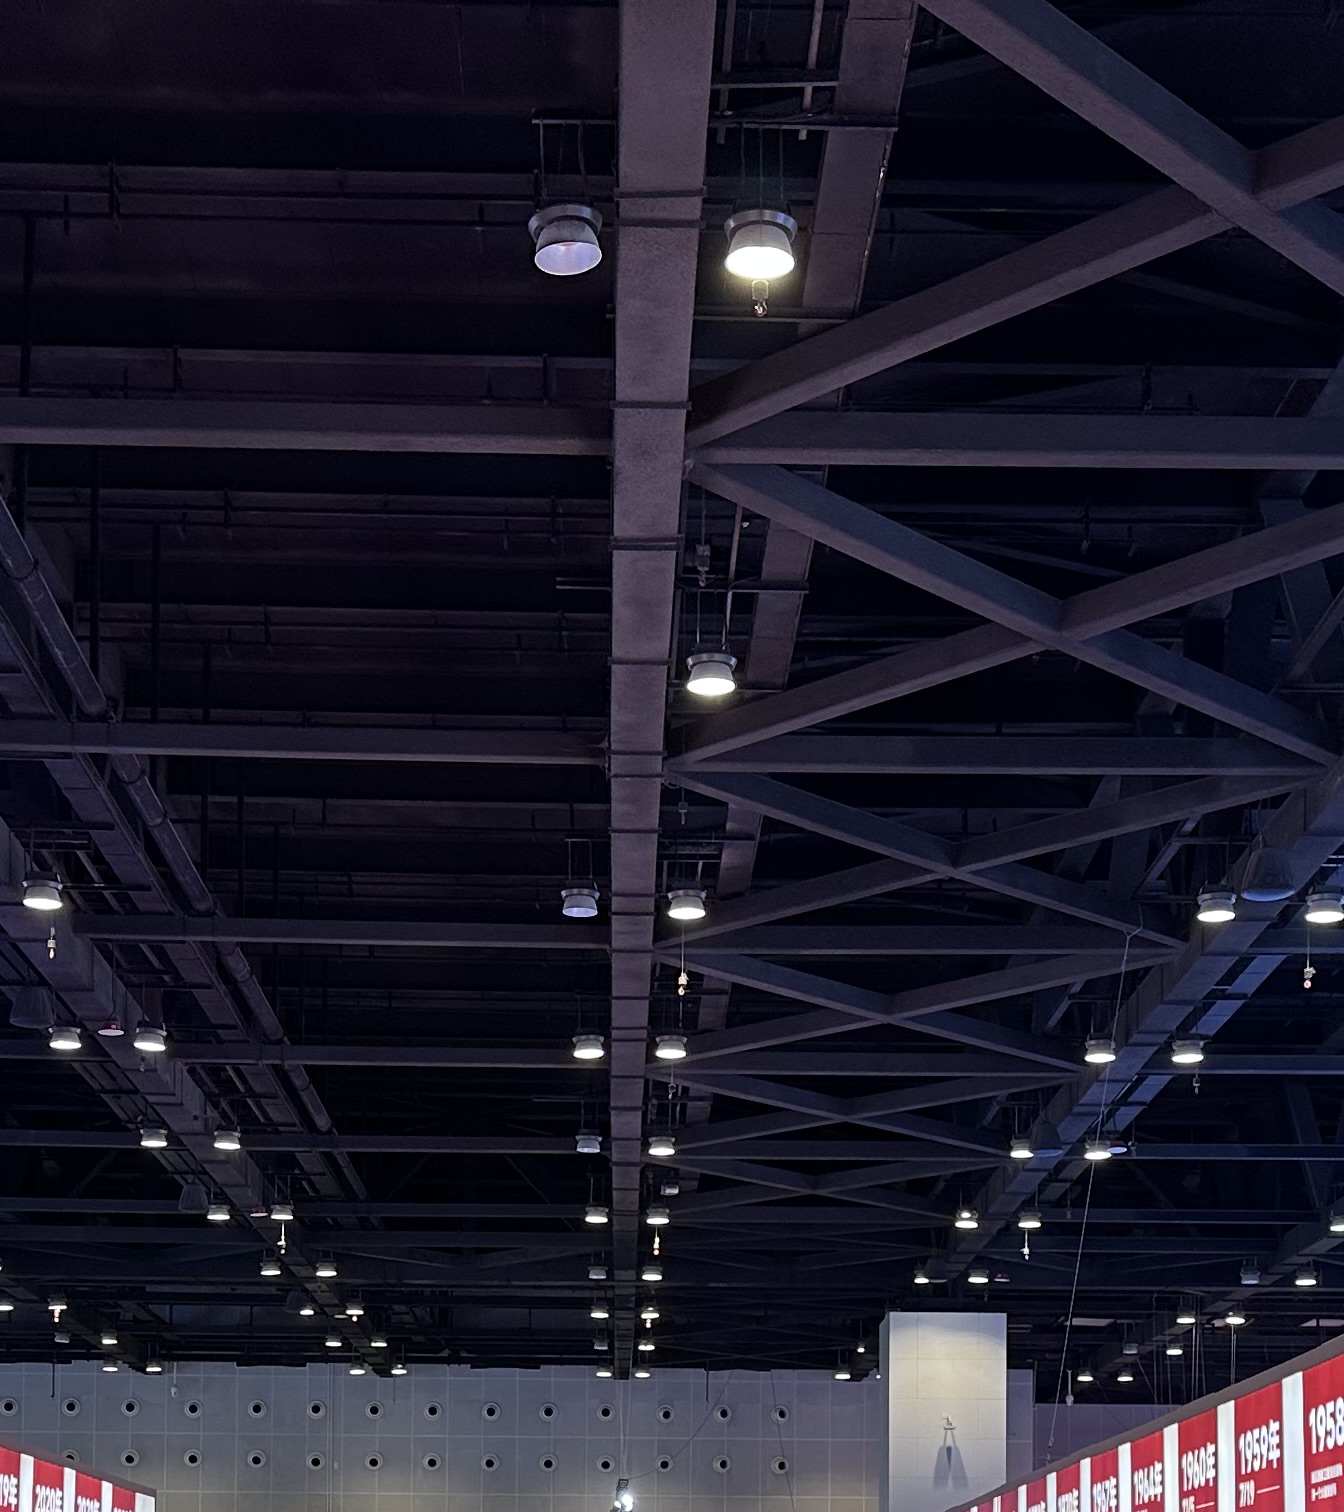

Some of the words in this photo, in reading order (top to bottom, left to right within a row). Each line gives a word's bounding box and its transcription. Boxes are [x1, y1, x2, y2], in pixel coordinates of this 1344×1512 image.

[1181, 1442, 1216, 1492] 1960年
[1239, 1419, 1280, 1475] 1959年
[1133, 1461, 1163, 1506] 1964年
[1239, 1479, 1255, 1508] 7/19
